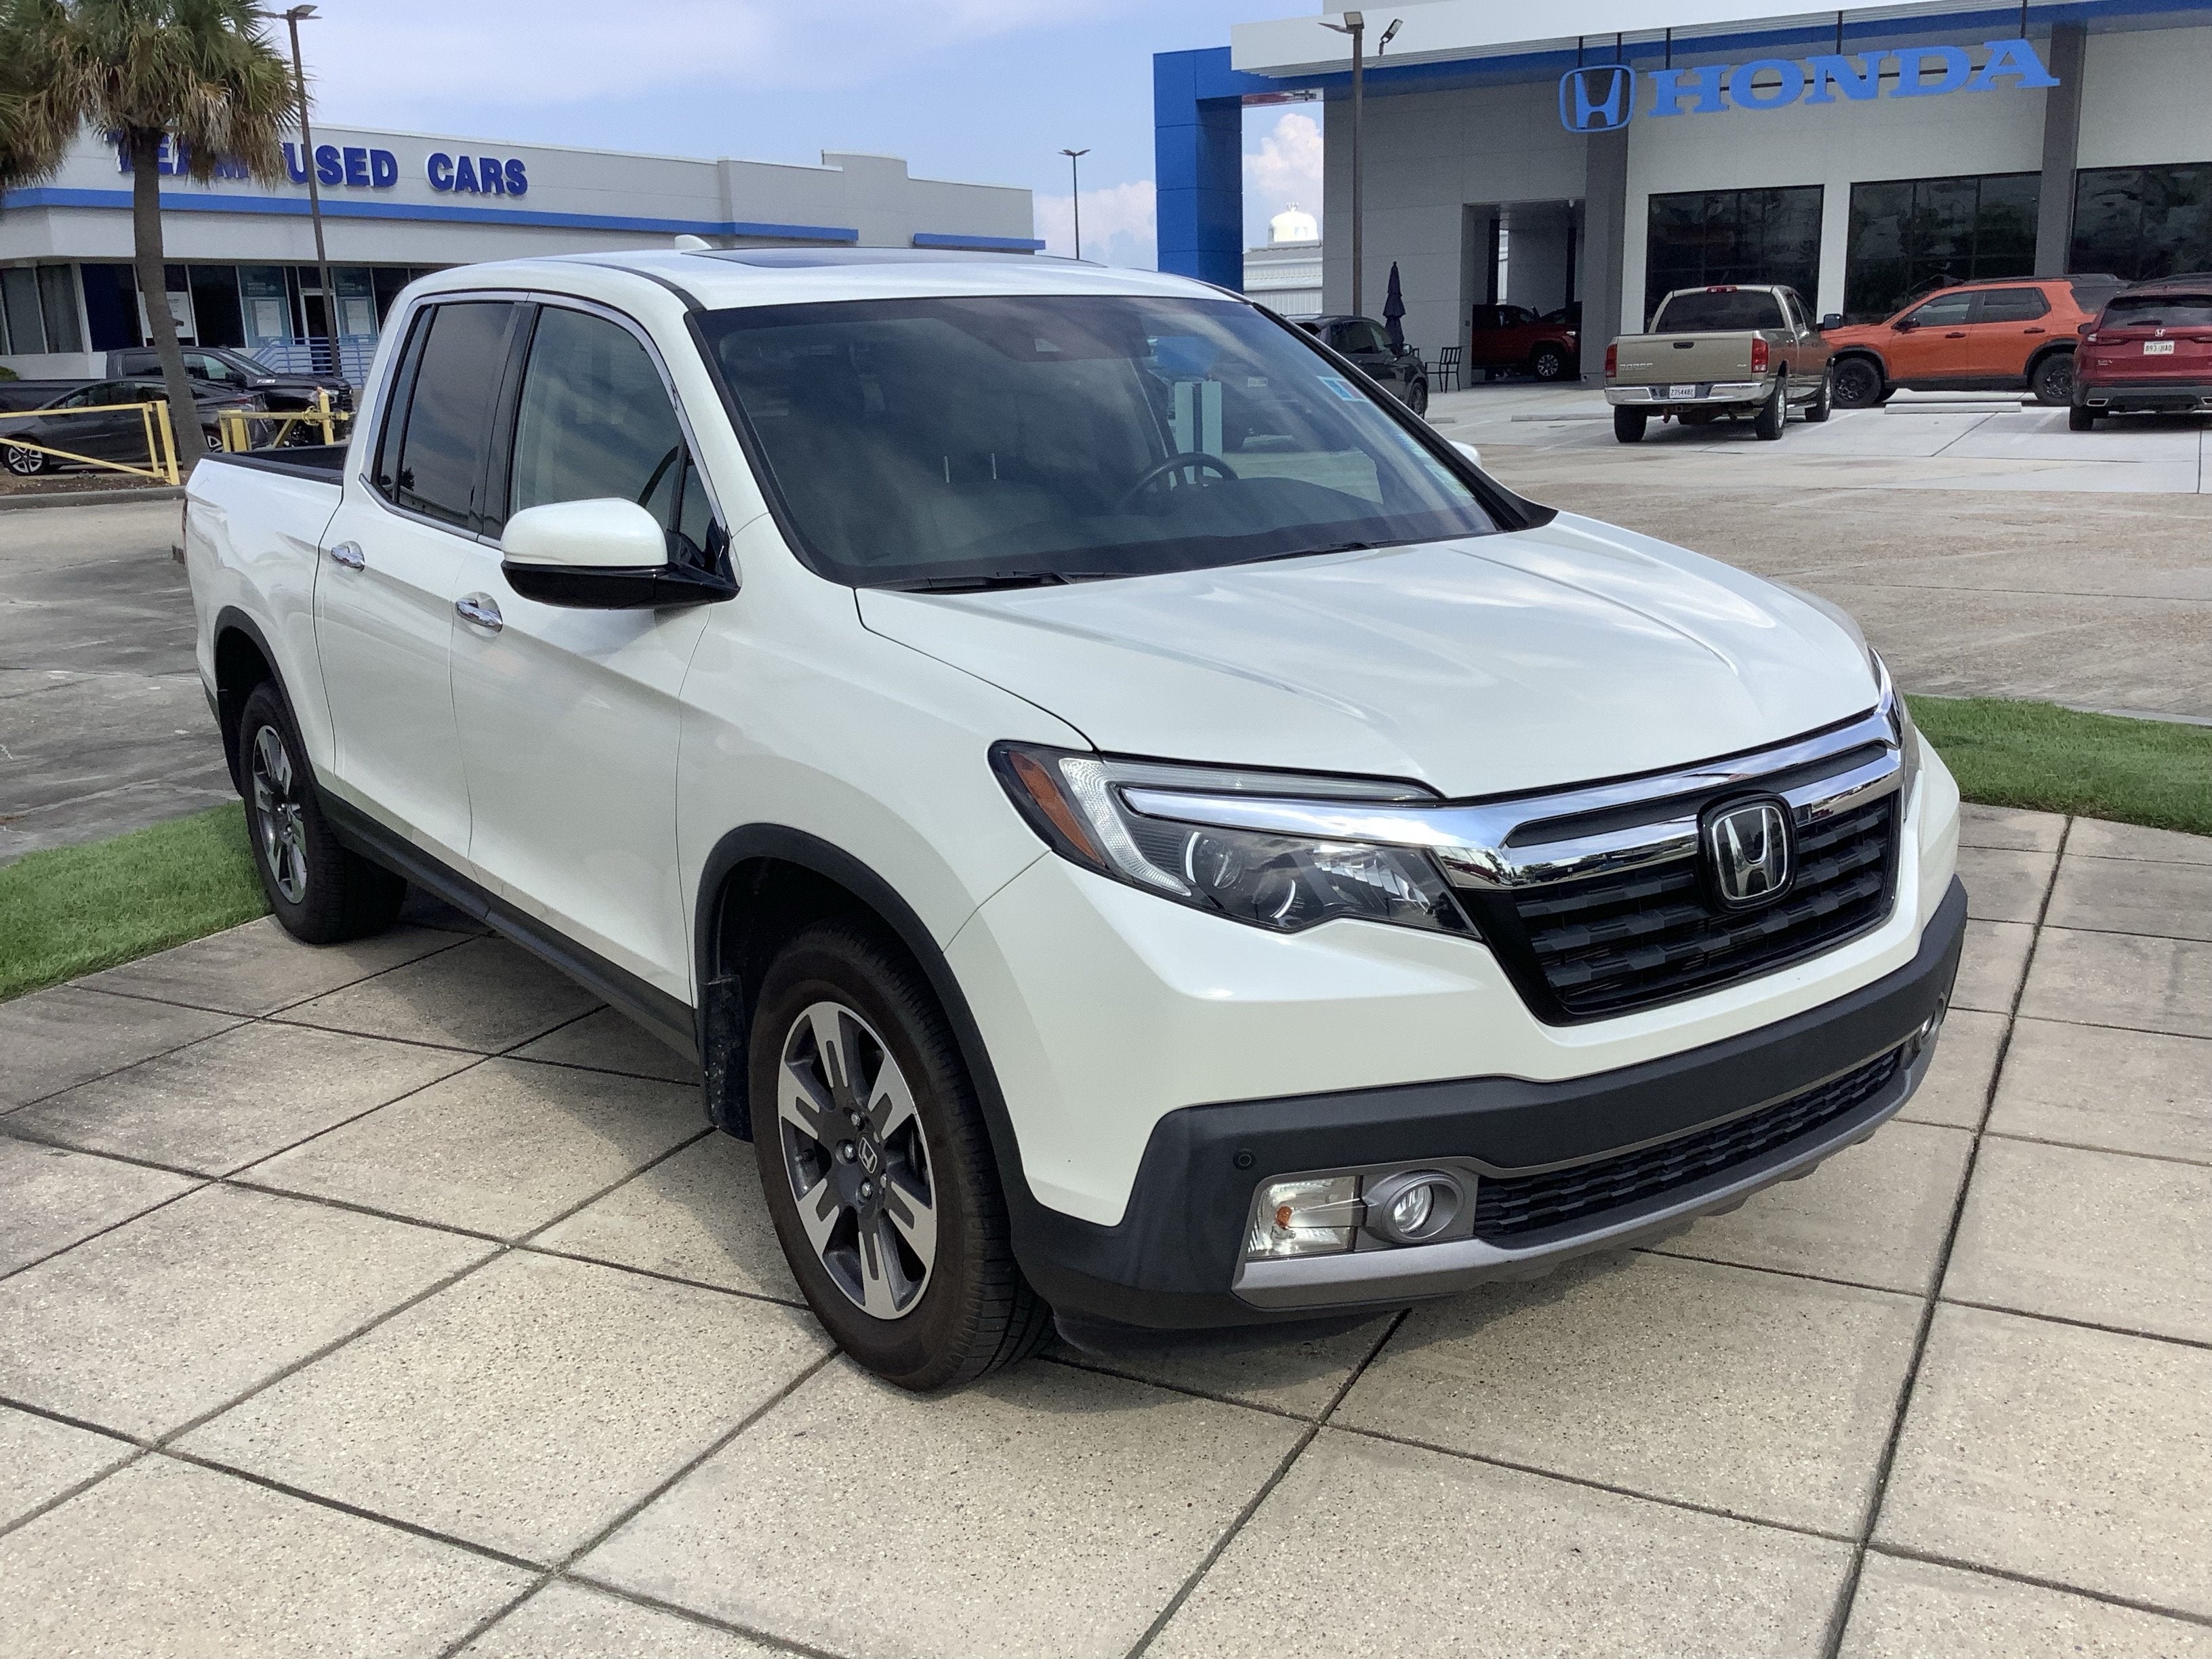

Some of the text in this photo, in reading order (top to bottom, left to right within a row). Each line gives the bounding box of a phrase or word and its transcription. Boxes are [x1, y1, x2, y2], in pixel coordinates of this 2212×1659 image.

[1647, 38, 2061, 117] HONDA
[283, 142, 398, 188] USED
[426, 152, 528, 196] CARS
